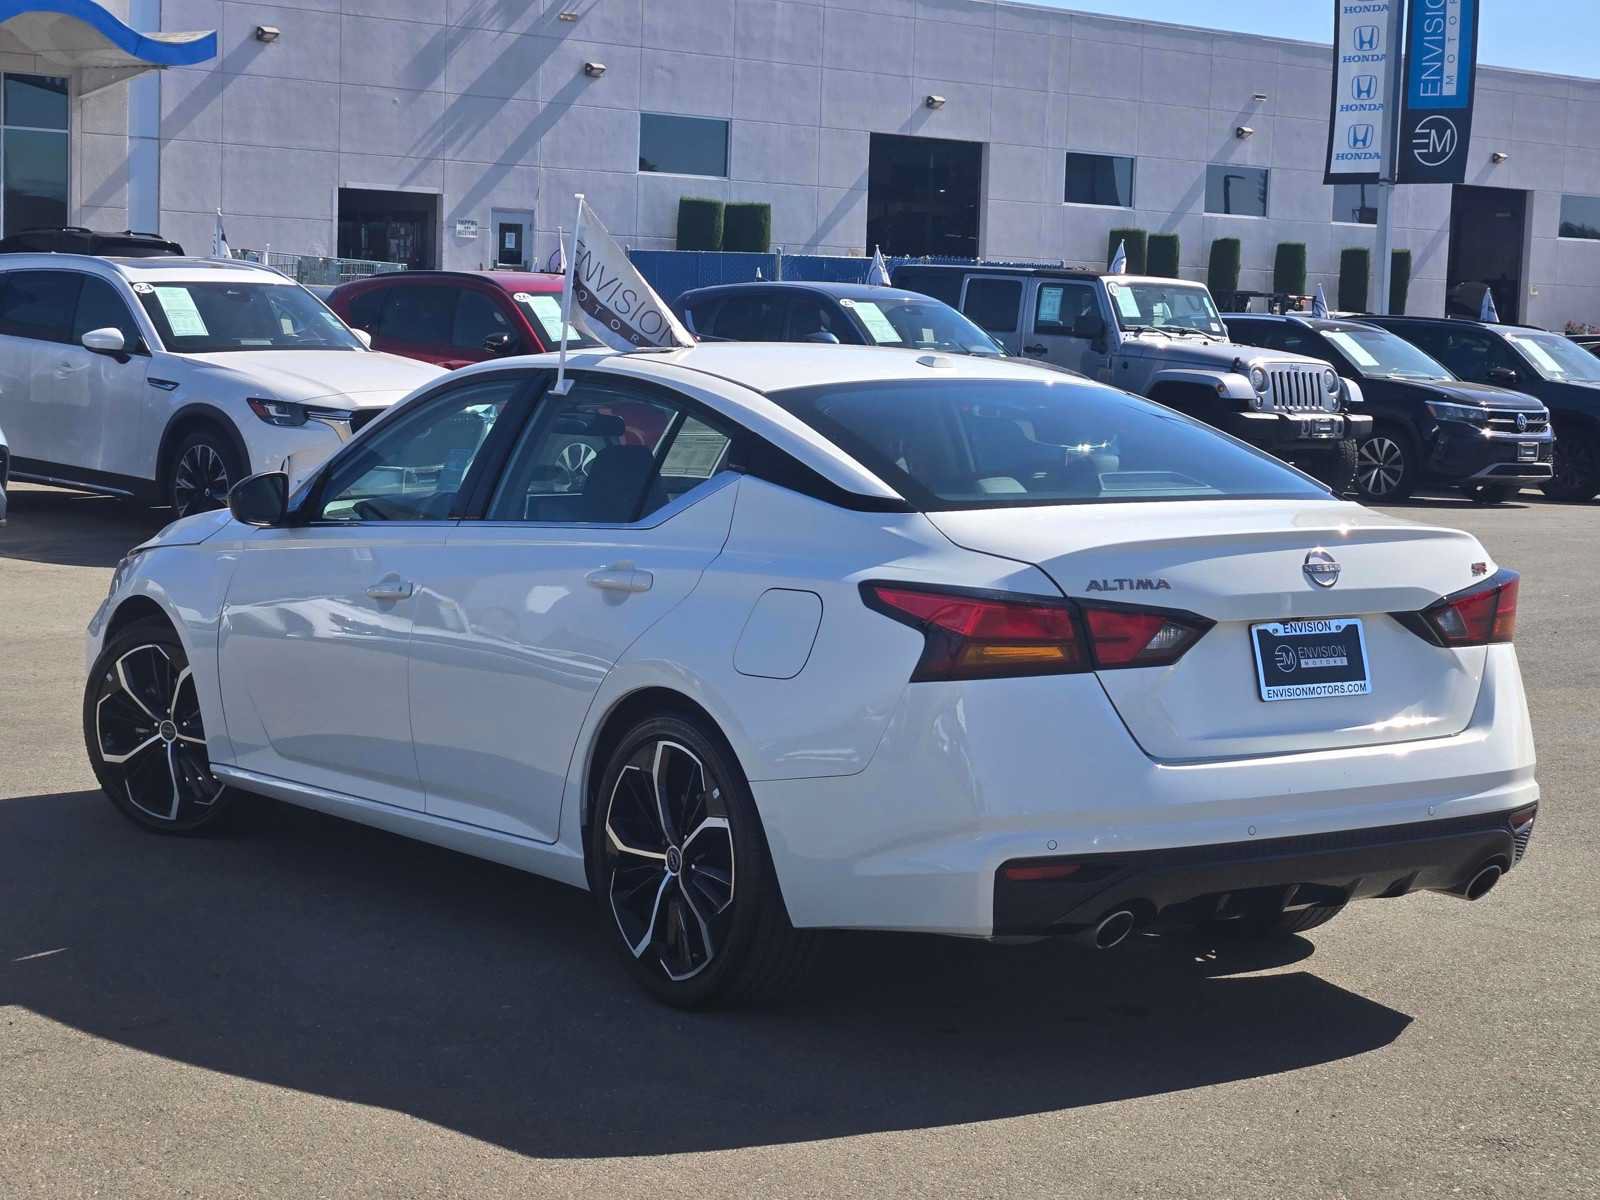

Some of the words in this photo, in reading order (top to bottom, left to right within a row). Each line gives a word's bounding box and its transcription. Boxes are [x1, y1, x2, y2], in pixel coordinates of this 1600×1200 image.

[1343, 4, 1391, 14] HONDA
[1335, 152, 1382, 160] HONDA
[1085, 578, 1171, 592] ALTIMA
[1283, 621, 1332, 634] ENVISION
[1297, 645, 1347, 659] ENVISION
[1267, 683, 1367, 699] ENVISIONMOTORS.COM
